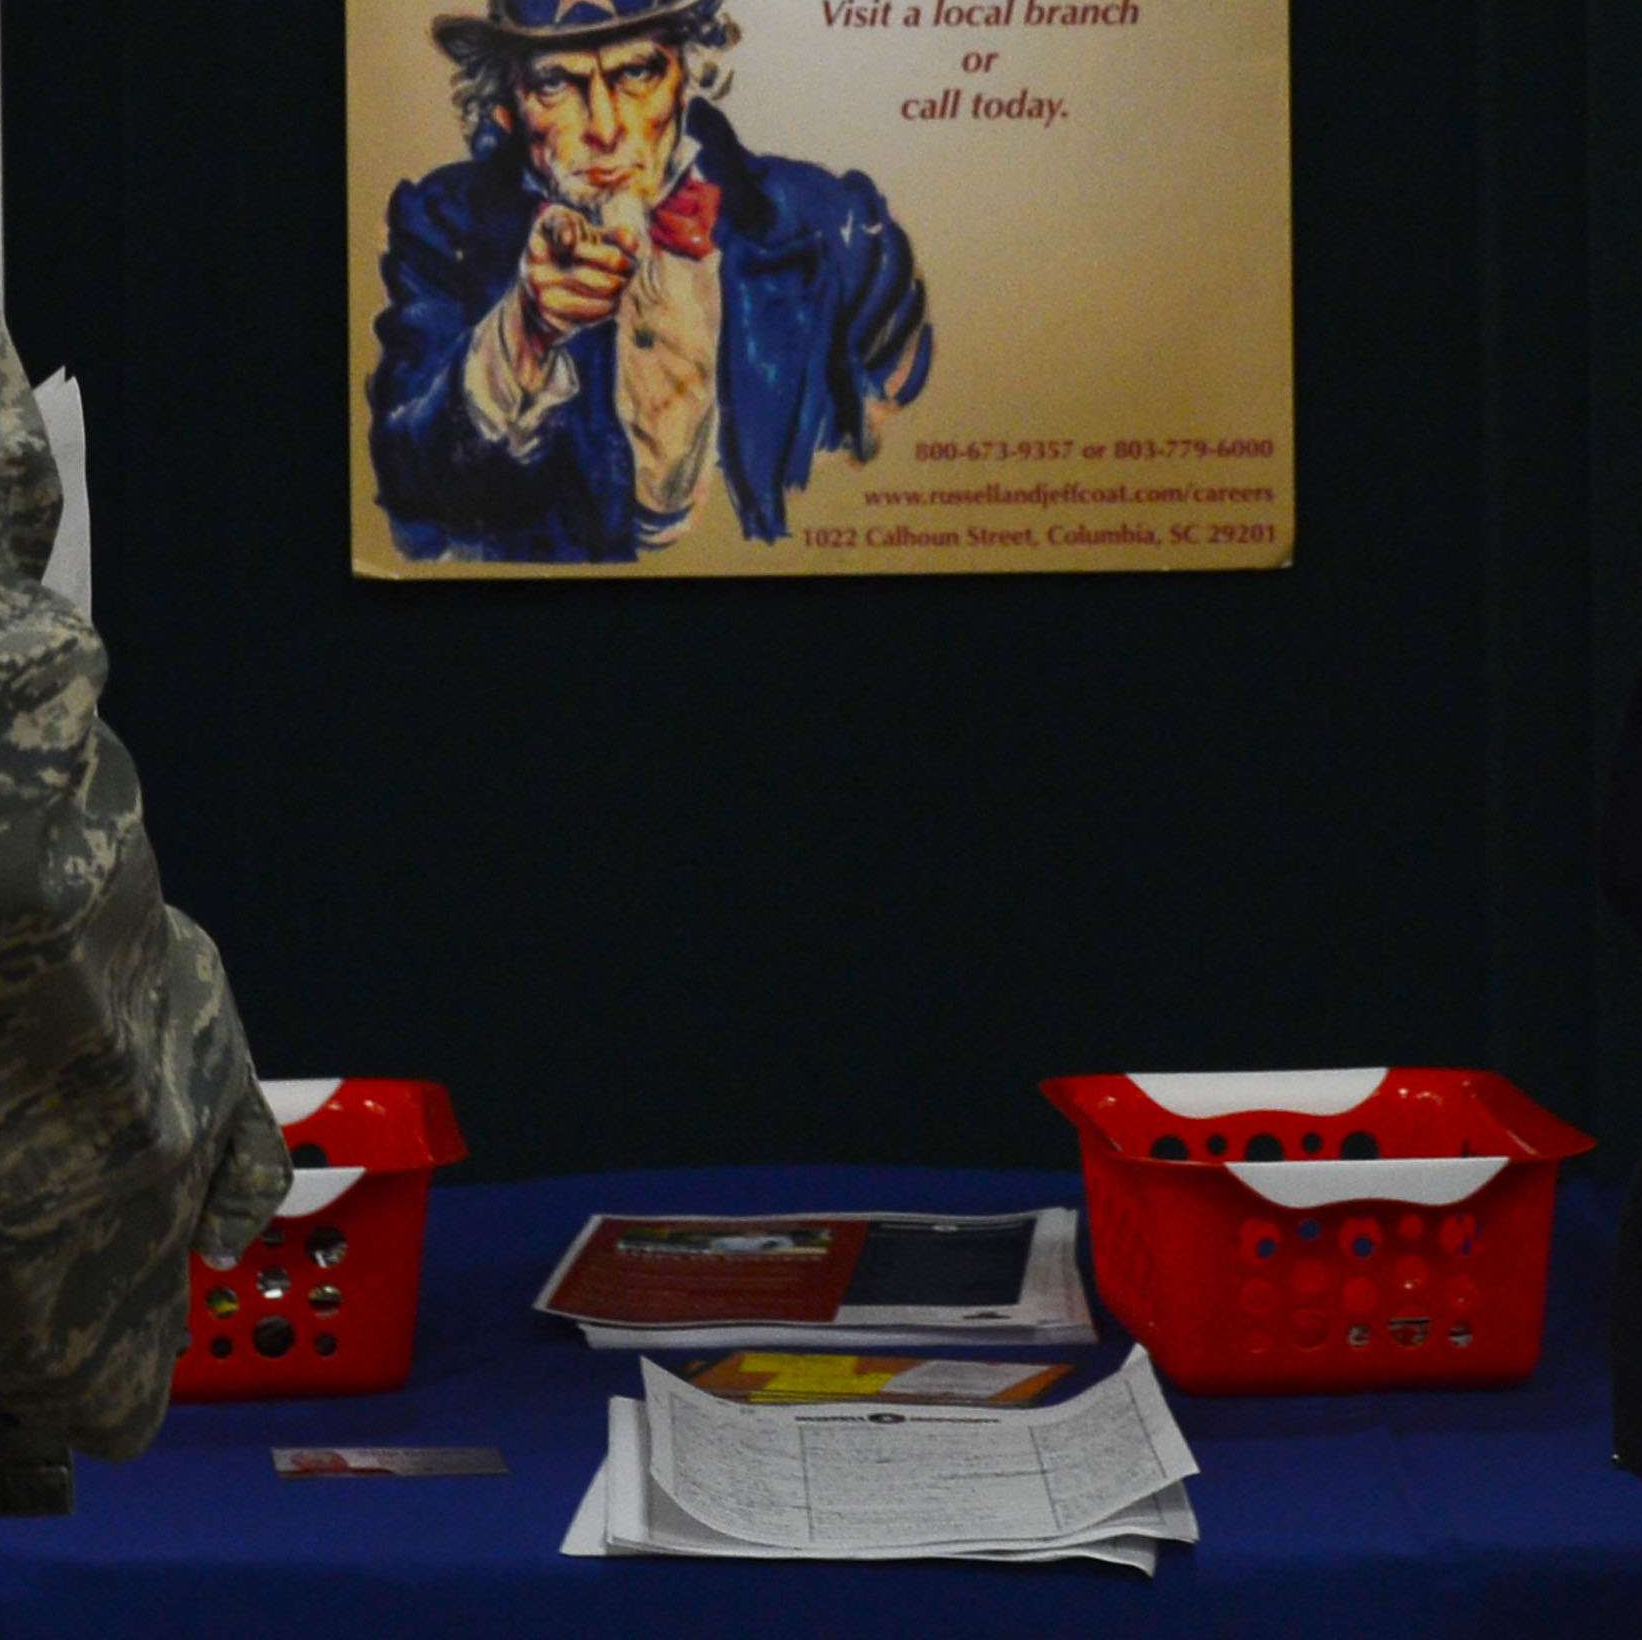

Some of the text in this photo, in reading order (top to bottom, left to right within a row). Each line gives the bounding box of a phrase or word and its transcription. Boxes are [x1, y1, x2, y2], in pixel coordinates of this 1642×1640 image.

[903, 7, 921, 27] a
[961, 52, 999, 73] or
[901, 88, 1068, 128] call today.
[916, 439, 1274, 461] 800-673-9357 or 803-779-6000
[864, 482, 1275, 510] www.russellandjeffcoat.com/careers
[804, 528, 858, 549] 1022
[865, 526, 960, 547] Calhoun
[1047, 522, 1162, 547] Columbia,
[1170, 525, 1197, 544] SC
[1208, 524, 1276, 544] 29201
